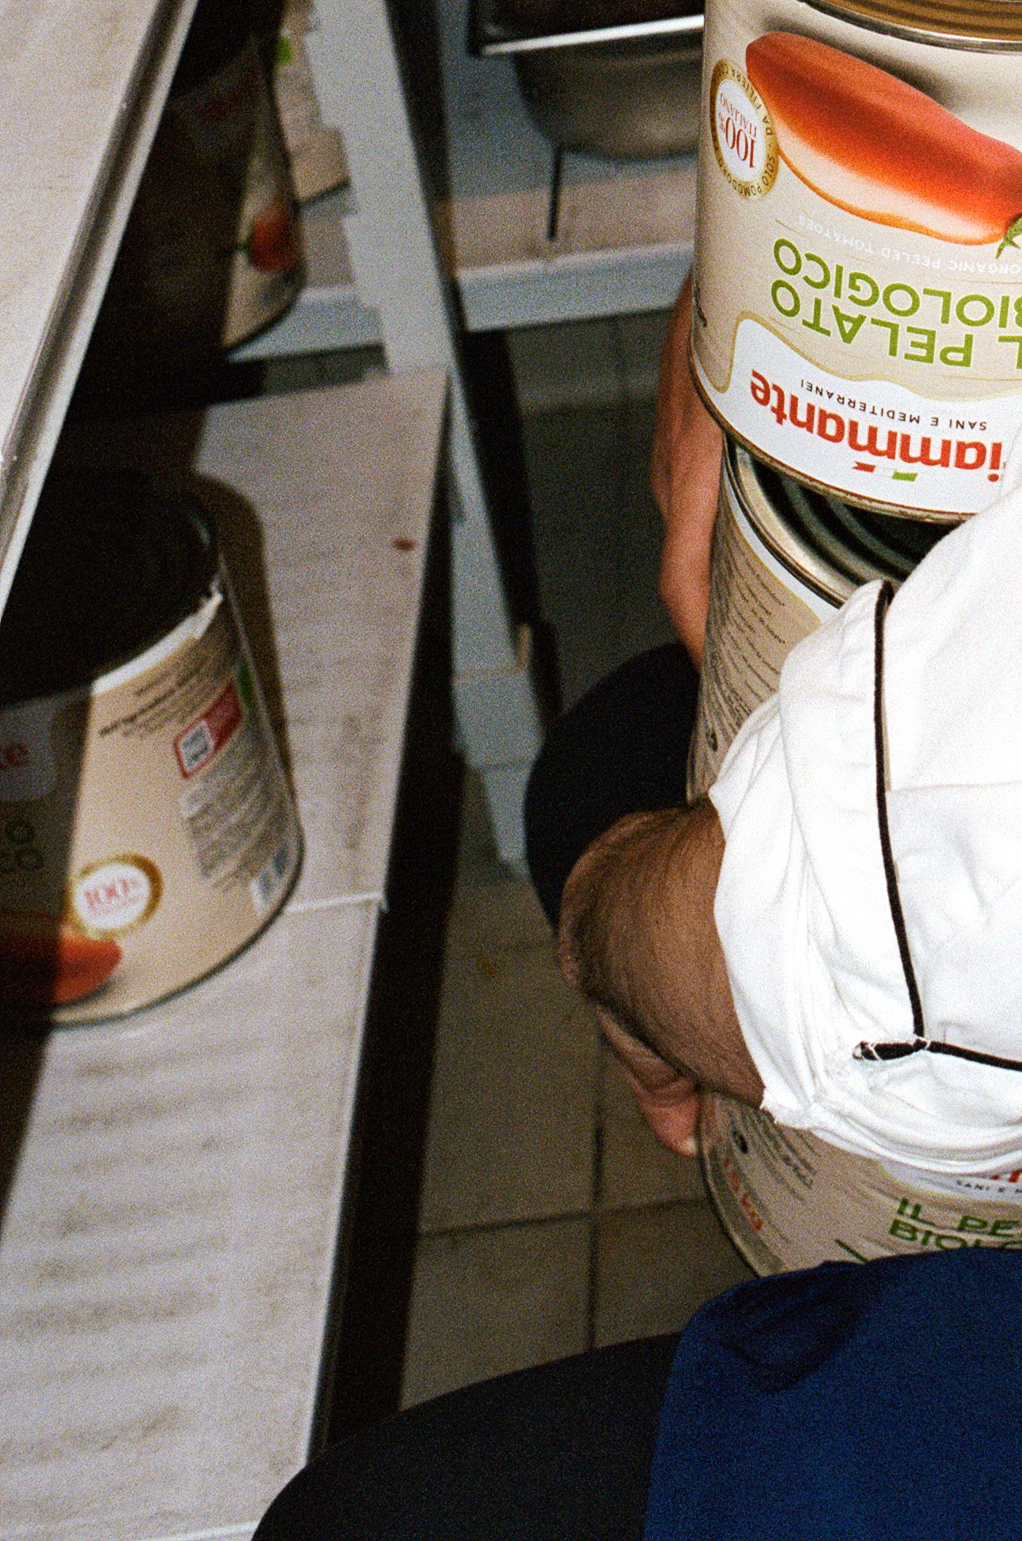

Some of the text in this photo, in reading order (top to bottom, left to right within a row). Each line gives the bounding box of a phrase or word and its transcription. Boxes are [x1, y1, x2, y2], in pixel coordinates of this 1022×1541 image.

[718, 112, 758, 169] 100%
[761, 153, 776, 187] SOLO
[794, 212, 1022, 276] ORGANIC PEELED TOMATOES
[770, 278, 974, 369] PELATO
[749, 369, 1006, 483] iammante
[799, 378, 988, 432] SANI E MEDITERRANEI
[896, 1197, 935, 1227] IL
